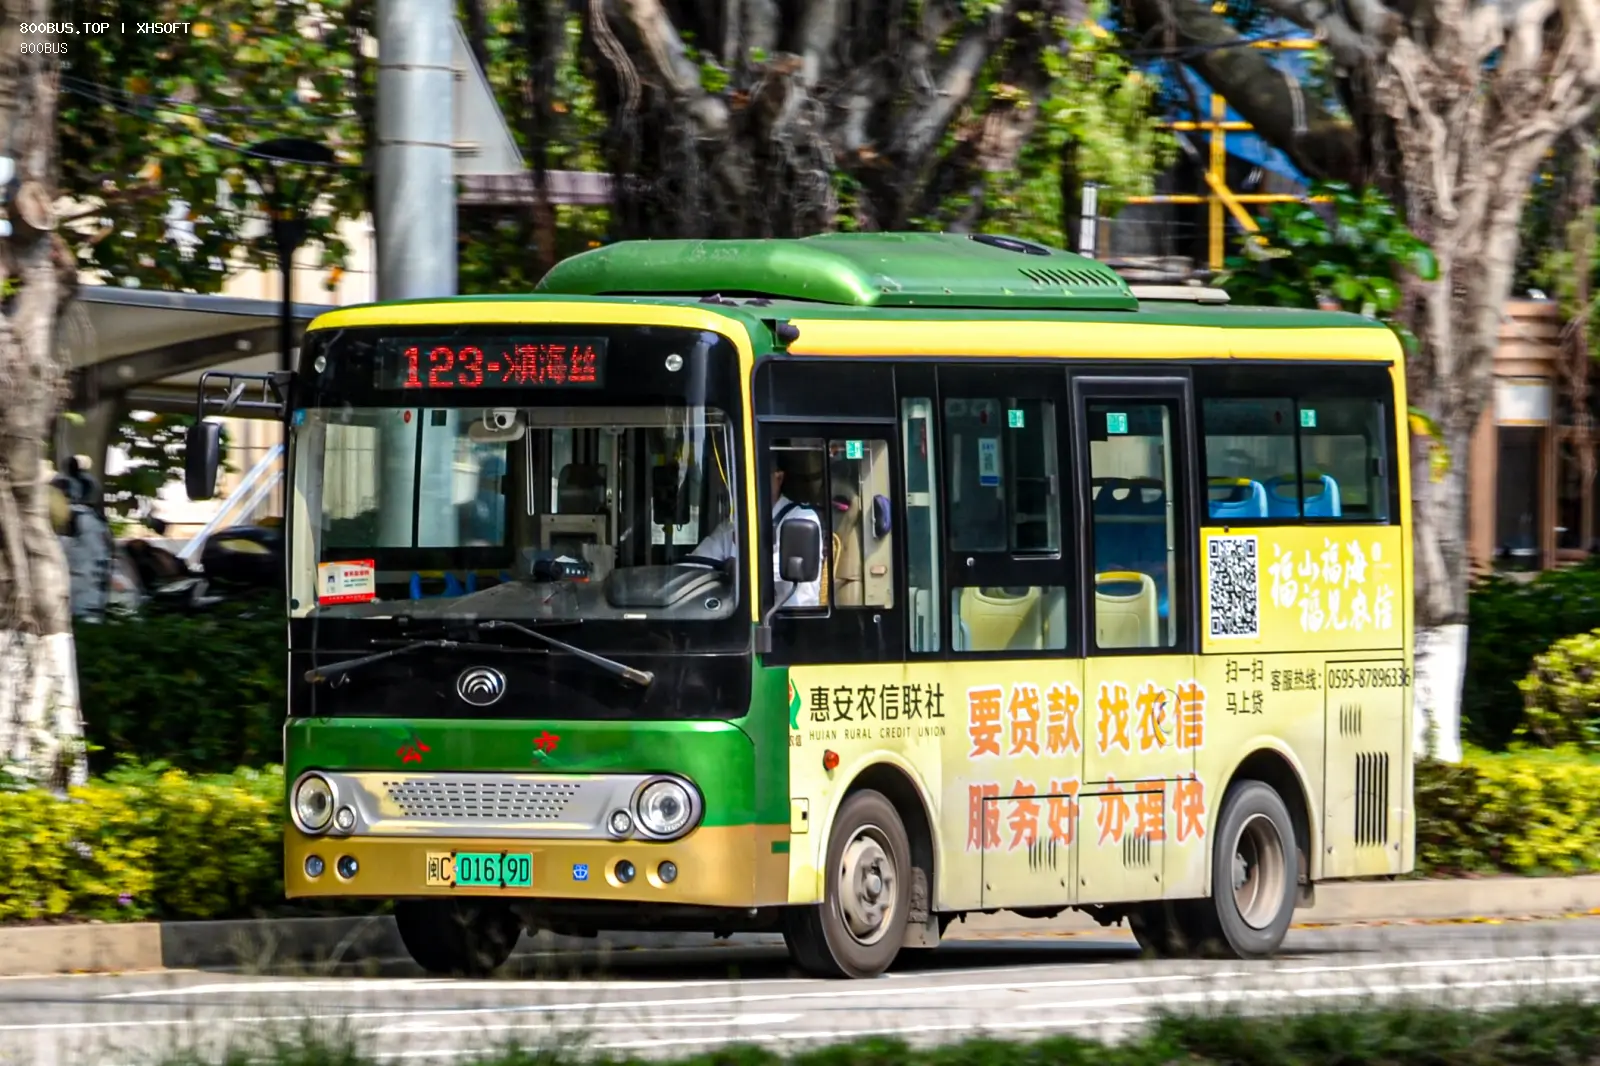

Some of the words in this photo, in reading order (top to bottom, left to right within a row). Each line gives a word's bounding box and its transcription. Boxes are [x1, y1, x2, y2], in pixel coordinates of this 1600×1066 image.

[1226, 658, 1264, 684] 扫一扫
[810, 683, 945, 722] 惠安农信联社
[1226, 690, 1264, 716] 马上贷
[809, 729, 837, 741] HUIAN
[844, 728, 872, 740] RURAL
[879, 726, 911, 739] CREDIT
[918, 725, 946, 737] UNION
[967, 685, 1081, 757] 要贷款
[1097, 683, 1206, 753] 找农信
[967, 779, 1081, 851] 服务好
[1097, 772, 1206, 845] 办理快
